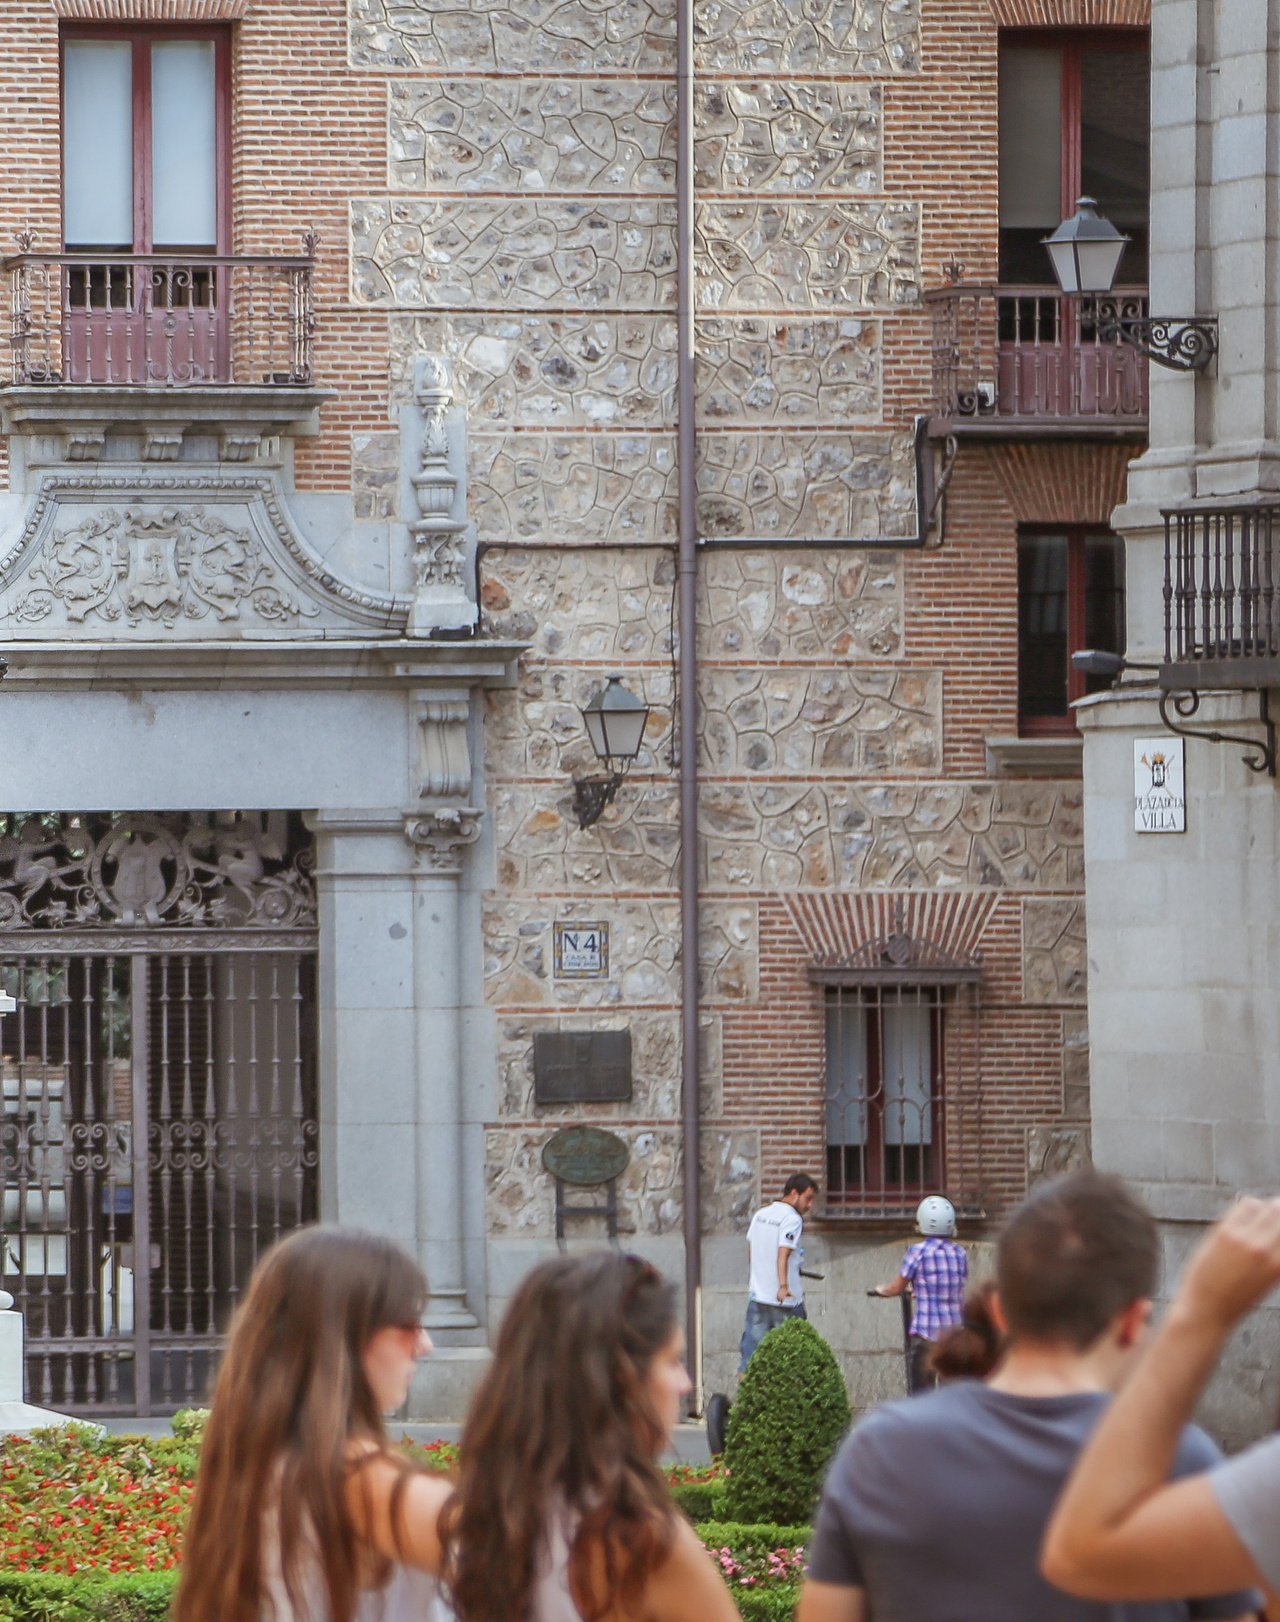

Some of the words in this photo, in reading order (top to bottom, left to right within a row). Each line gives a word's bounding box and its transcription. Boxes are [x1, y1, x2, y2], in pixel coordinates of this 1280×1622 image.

[1135, 795, 1164, 811] PLAZA
[1141, 811, 1177, 829] VILLA
[583, 933, 598, 952] 4
